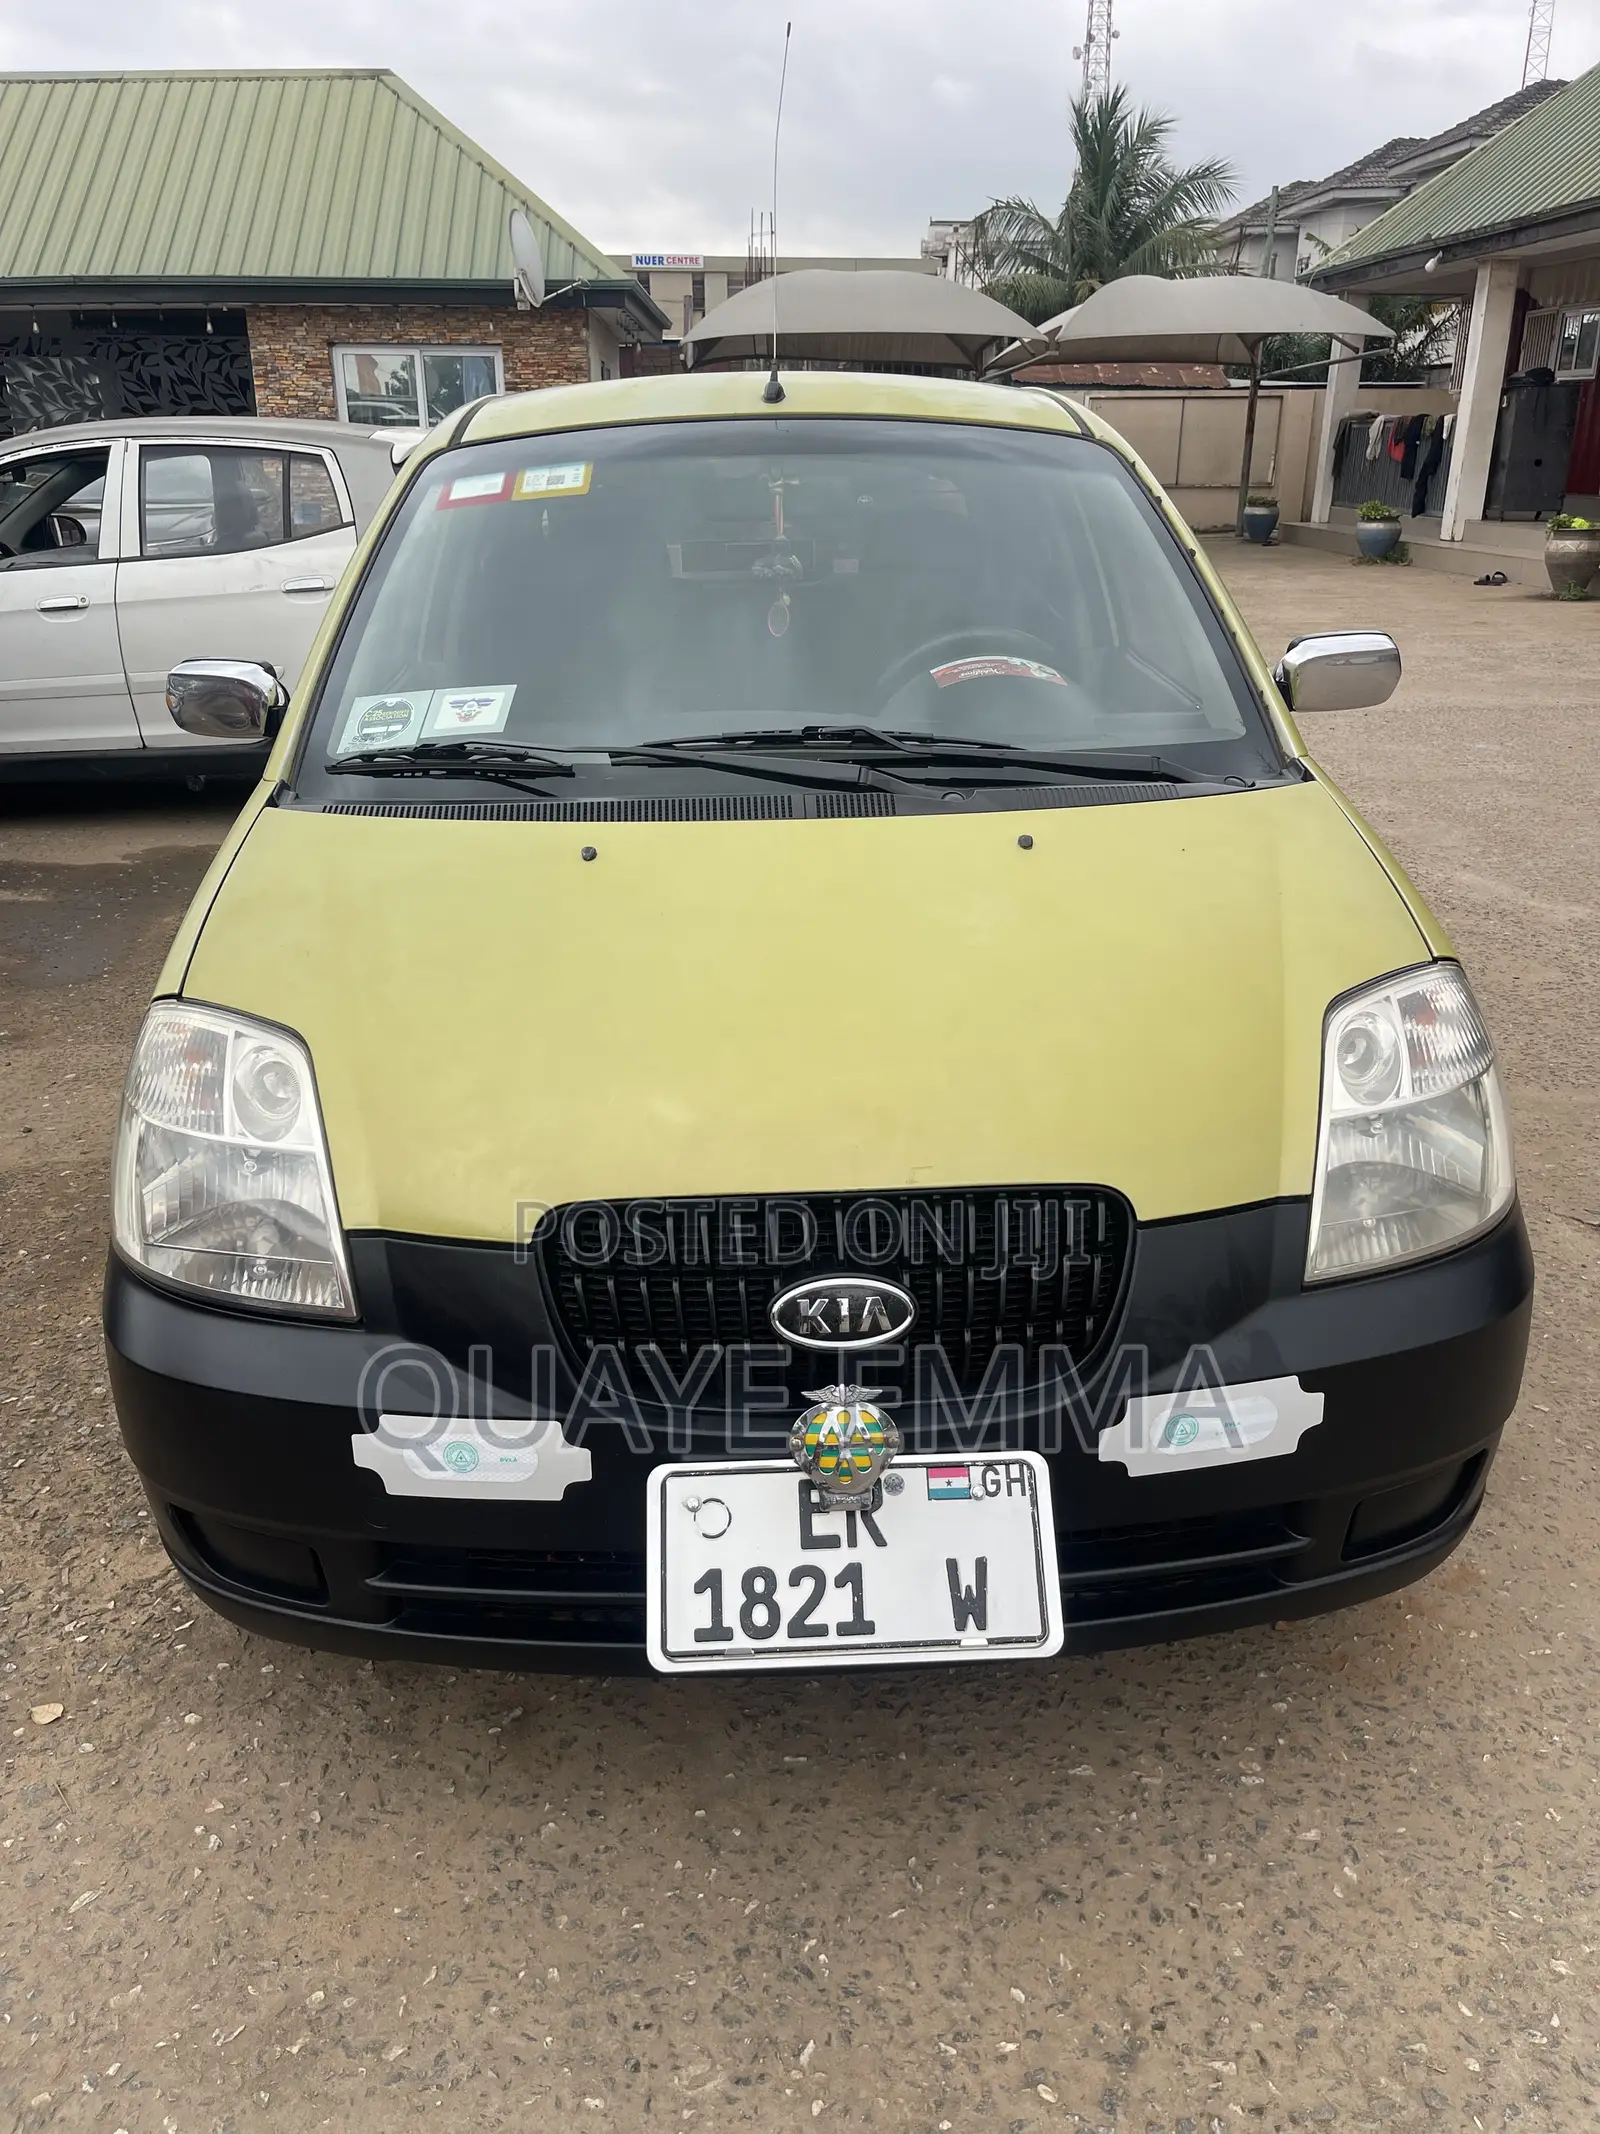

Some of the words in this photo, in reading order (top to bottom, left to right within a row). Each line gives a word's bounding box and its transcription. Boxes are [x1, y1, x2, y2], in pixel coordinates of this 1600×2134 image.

[635, 255, 664, 265] NUER
[666, 256, 700, 265] CENTRE
[798, 1296, 892, 1334] KIA
[982, 1463, 1027, 1498] GH
[799, 1478, 887, 1549] ER
[694, 1561, 875, 1642] 1821
[945, 1556, 988, 1632] W
